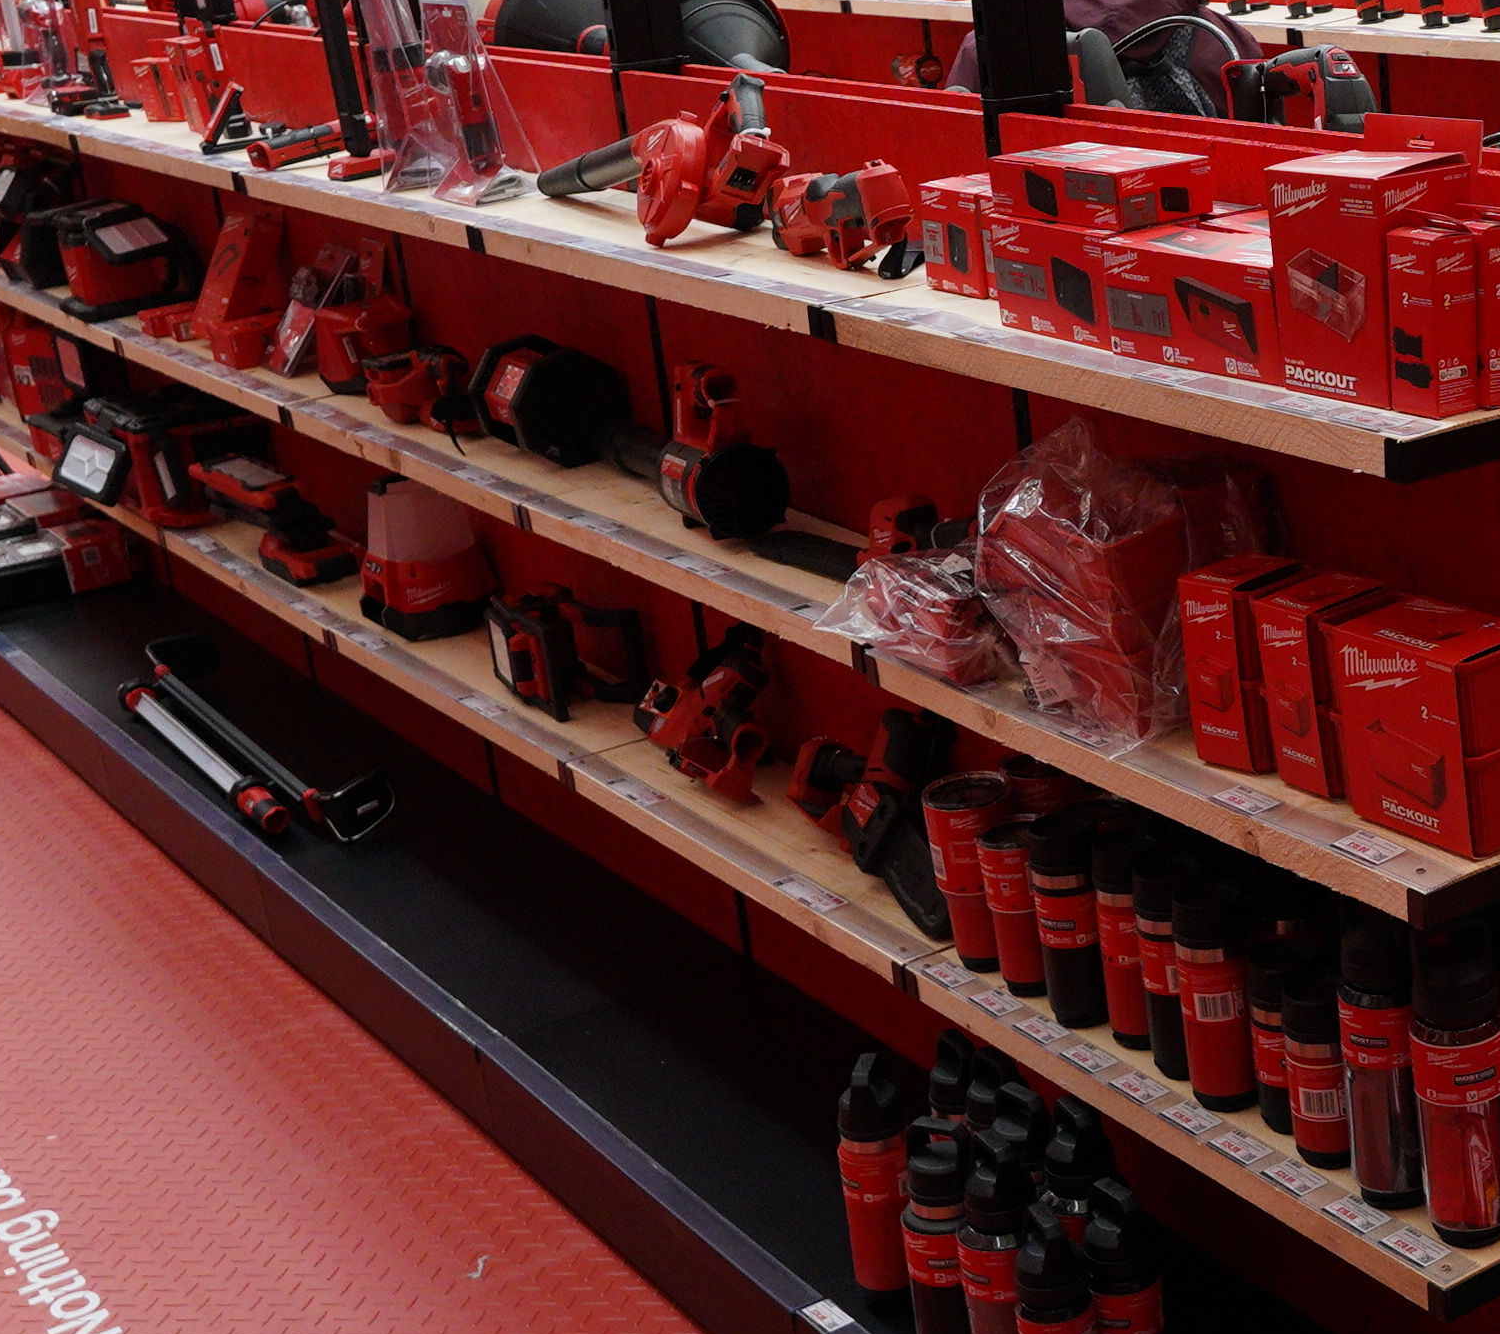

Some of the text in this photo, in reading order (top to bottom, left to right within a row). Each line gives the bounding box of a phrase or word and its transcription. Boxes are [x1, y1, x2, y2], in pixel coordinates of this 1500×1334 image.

[1271, 180, 1329, 208] Milwaukee
[1382, 181, 1428, 210] Milwaukee
[1103, 251, 1138, 270] Milwaukee
[1285, 364, 1358, 390] PACKOUT
[1185, 598, 1228, 621] Milwaukee
[1340, 645, 1418, 677] Milwaukee
[1201, 724, 1239, 740] PACKOUT
[1282, 747, 1317, 766] PACKOUT
[1381, 799, 1440, 829] PACKOUT
